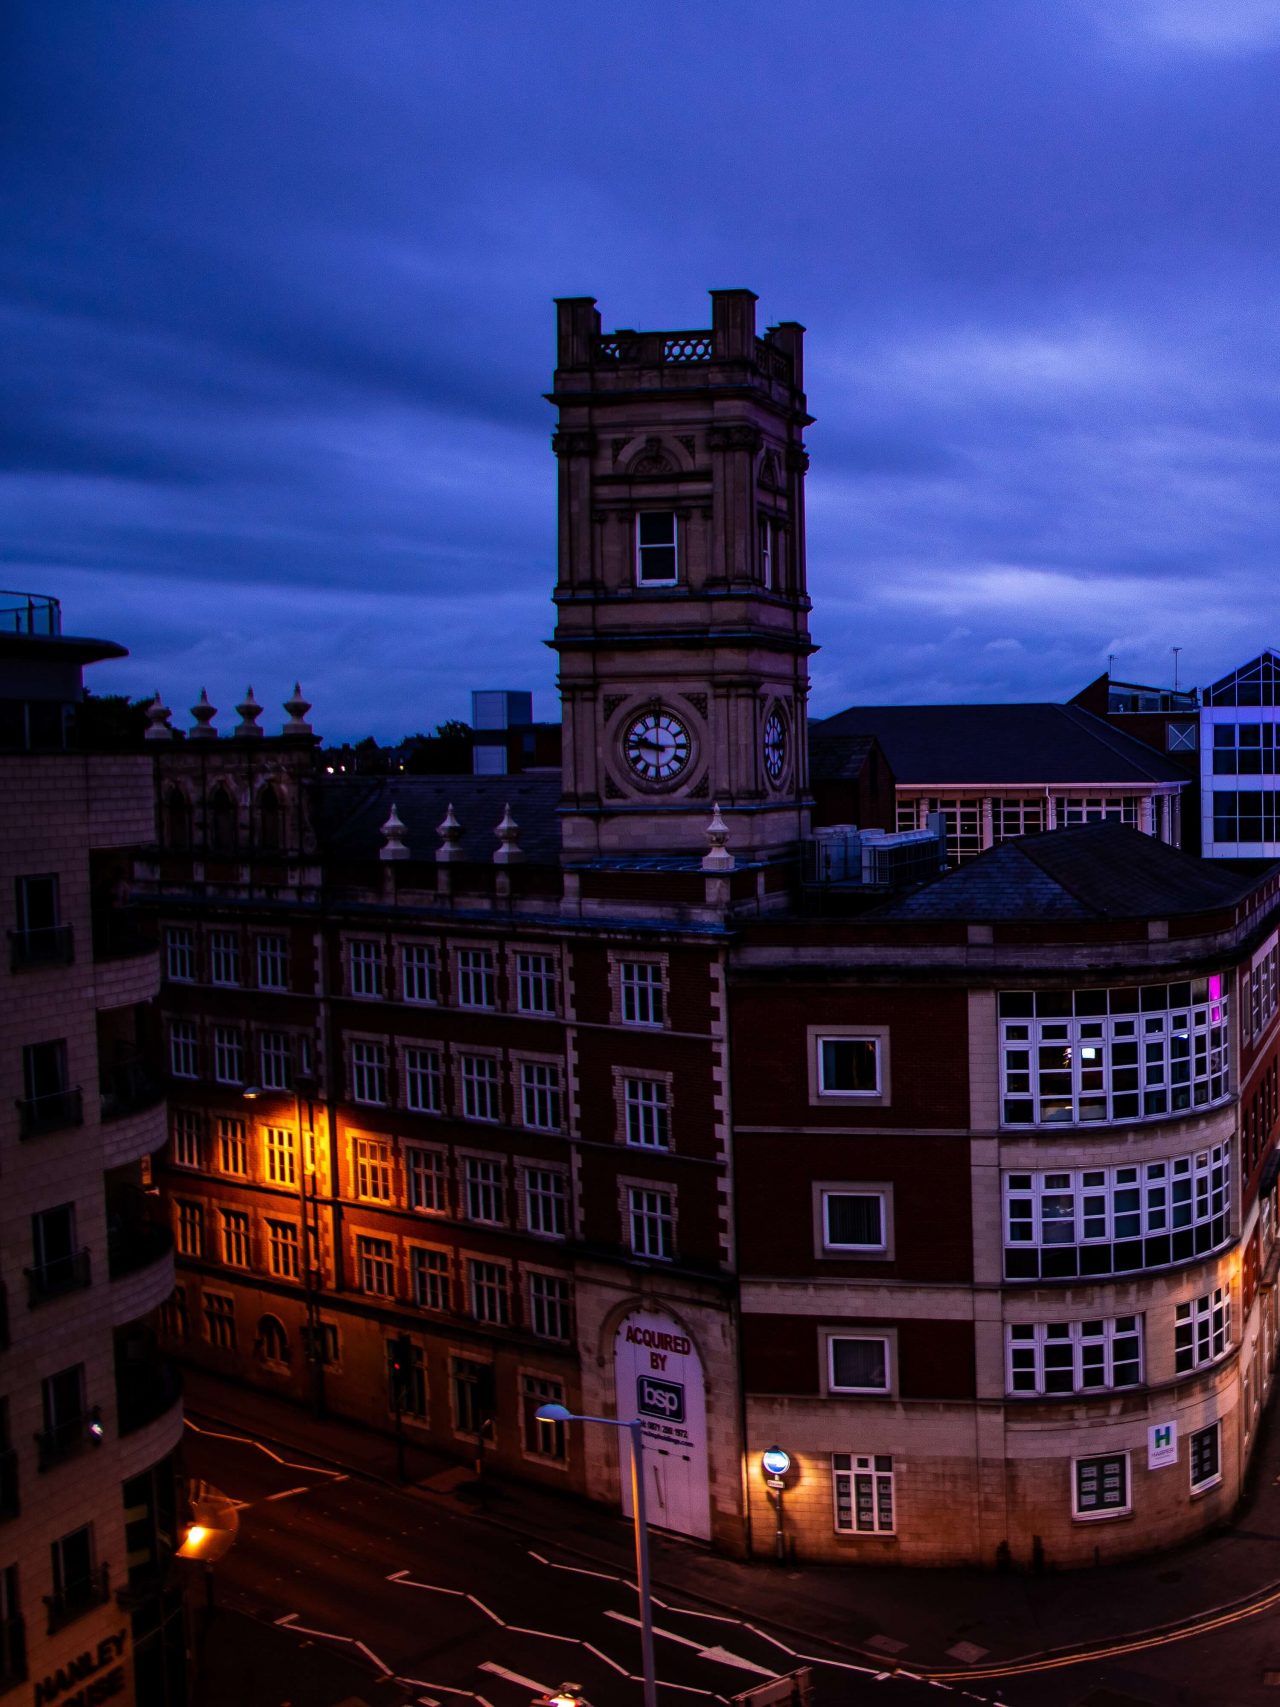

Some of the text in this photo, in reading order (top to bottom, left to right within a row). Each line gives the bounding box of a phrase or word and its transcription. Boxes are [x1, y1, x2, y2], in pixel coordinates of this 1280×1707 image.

[626, 1325, 691, 1356] ACQUIRED
[650, 1352, 667, 1371] BY
[643, 1380, 678, 1416] bsp
[34, 1628, 127, 1707] HANLEY
